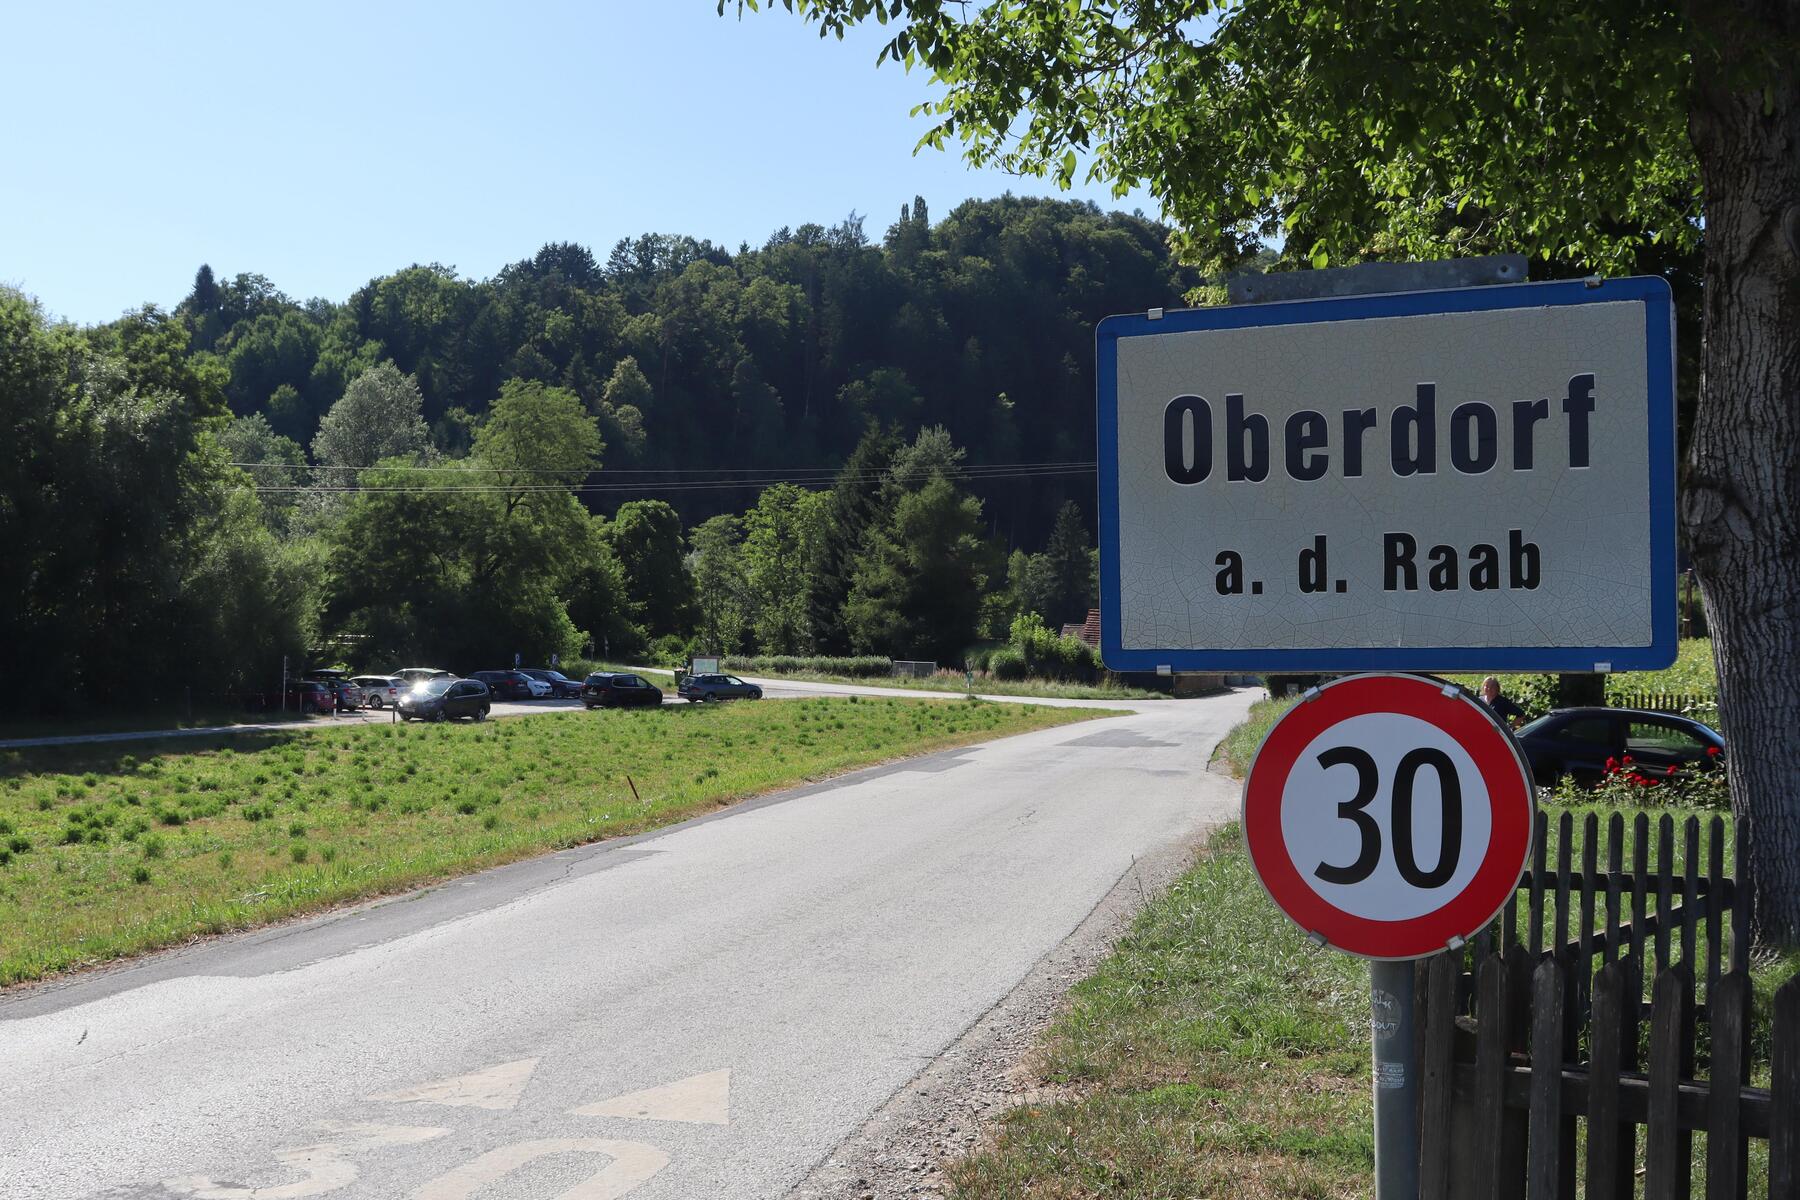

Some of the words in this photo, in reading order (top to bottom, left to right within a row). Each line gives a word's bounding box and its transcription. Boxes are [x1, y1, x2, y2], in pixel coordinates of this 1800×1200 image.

[1162, 372, 1597, 486] Oberdorf
[1214, 550, 1264, 596] a.
[1298, 534, 1348, 594] d.
[1383, 529, 1541, 592] Raab
[1313, 745, 1463, 889] 30
